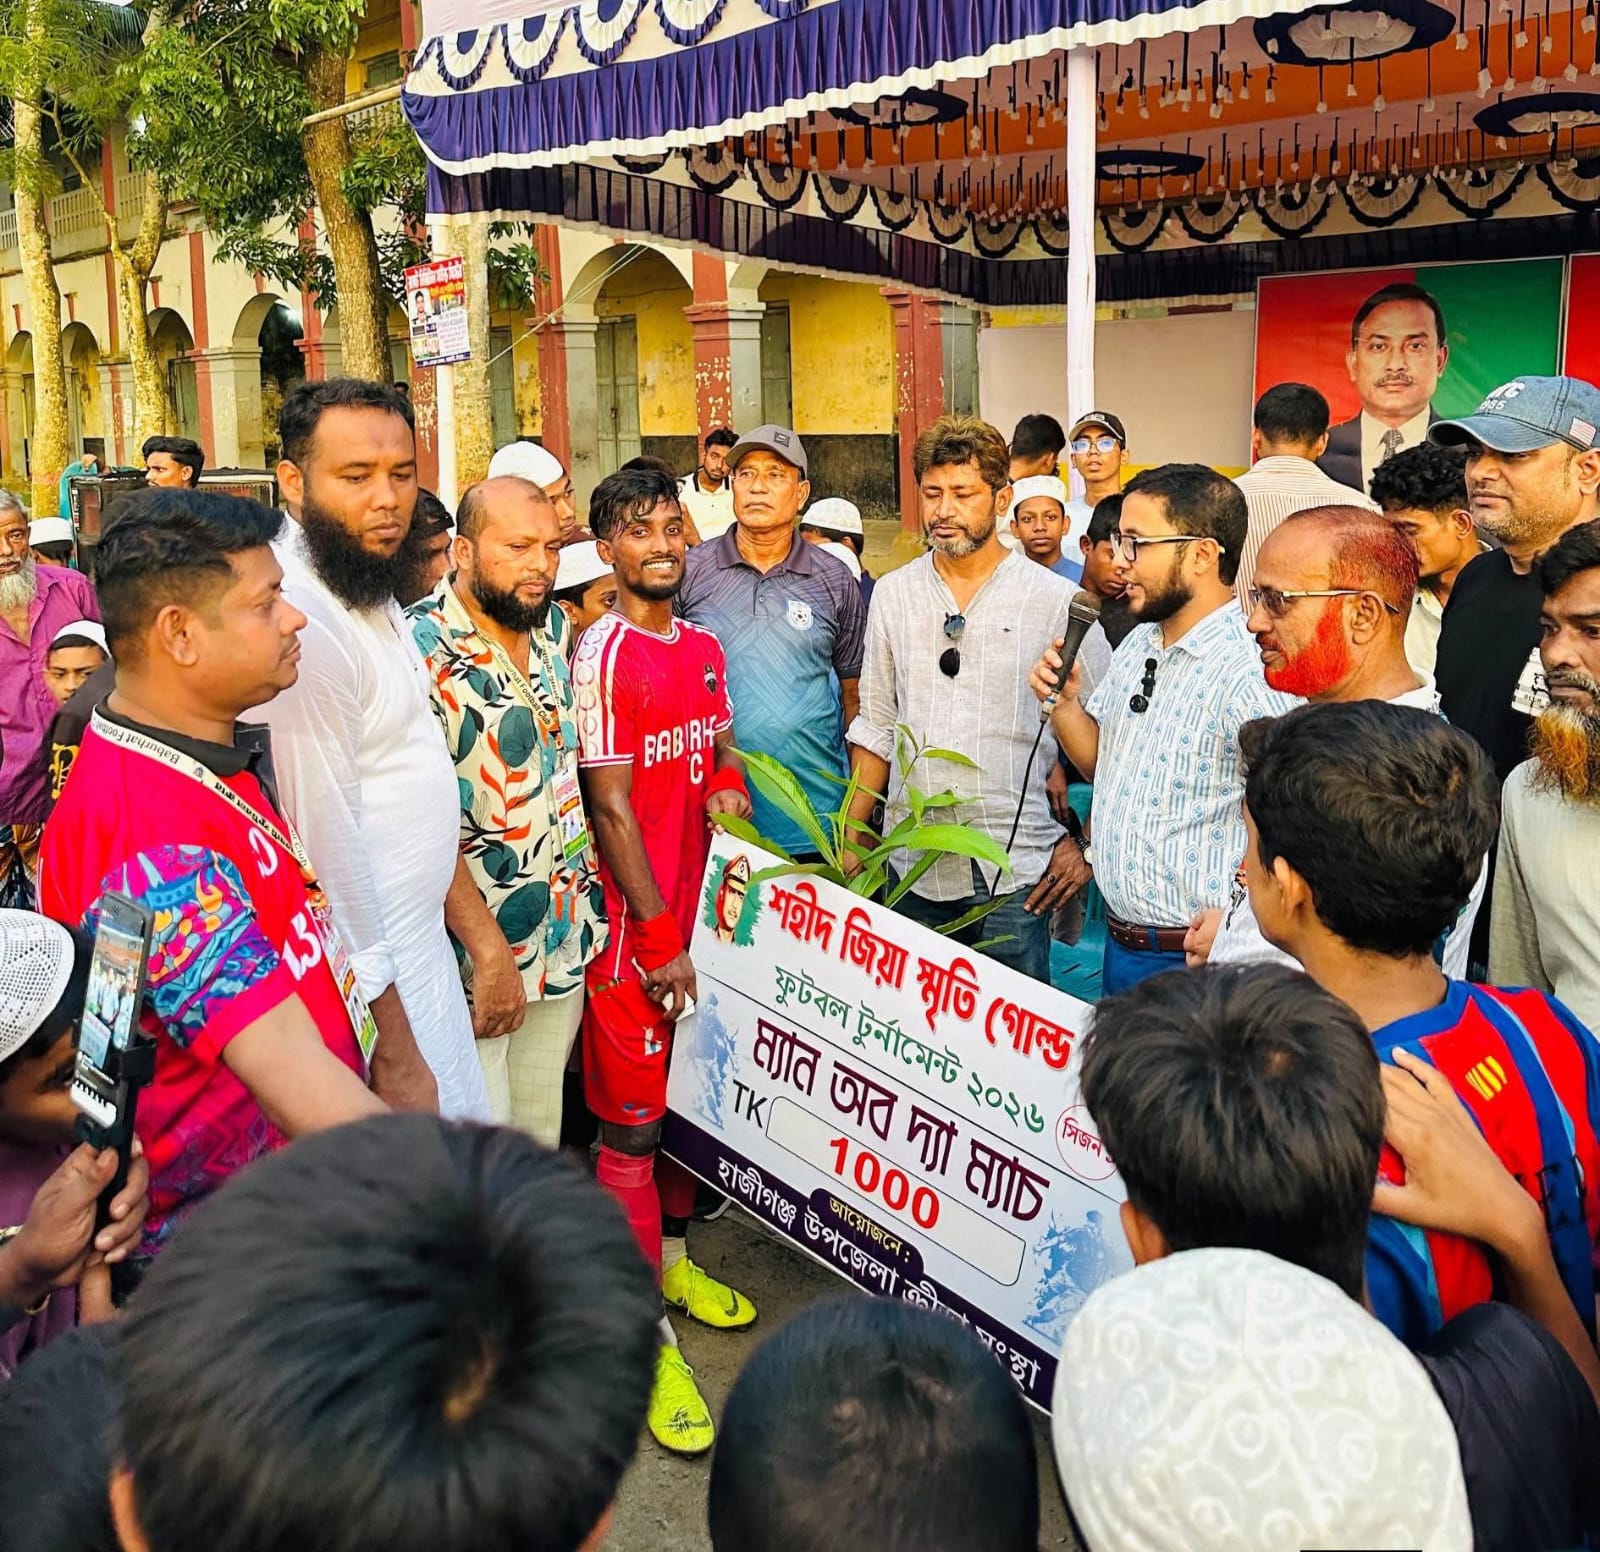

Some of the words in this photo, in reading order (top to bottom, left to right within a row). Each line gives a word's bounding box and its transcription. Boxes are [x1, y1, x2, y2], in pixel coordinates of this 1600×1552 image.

[125, 732, 180, 765] Baburhat
[537, 706, 551, 726] Club
[768, 881, 837, 951] শহীদ
[839, 906, 909, 988] জিয়া
[916, 956, 981, 1032] স্মৃতি
[984, 997, 1077, 1070] গোল্ড
[732, 1079, 768, 1129] TK
[774, 965, 852, 1029] ফুটবল
[852, 1000, 963, 1084] টুর্নামেন্ট
[967, 1071, 1046, 1132] ২০২৬
[753, 1017, 822, 1096] ম্যান
[830, 1060, 898, 1141] অব
[906, 1104, 958, 1176] দ্যা
[965, 1138, 1051, 1221] ম্যাচ
[718, 1156, 797, 1231] হাজীগঞ্জ
[804, 1205, 899, 1296] উপজেলা
[829, 1136, 941, 1229] 1000
